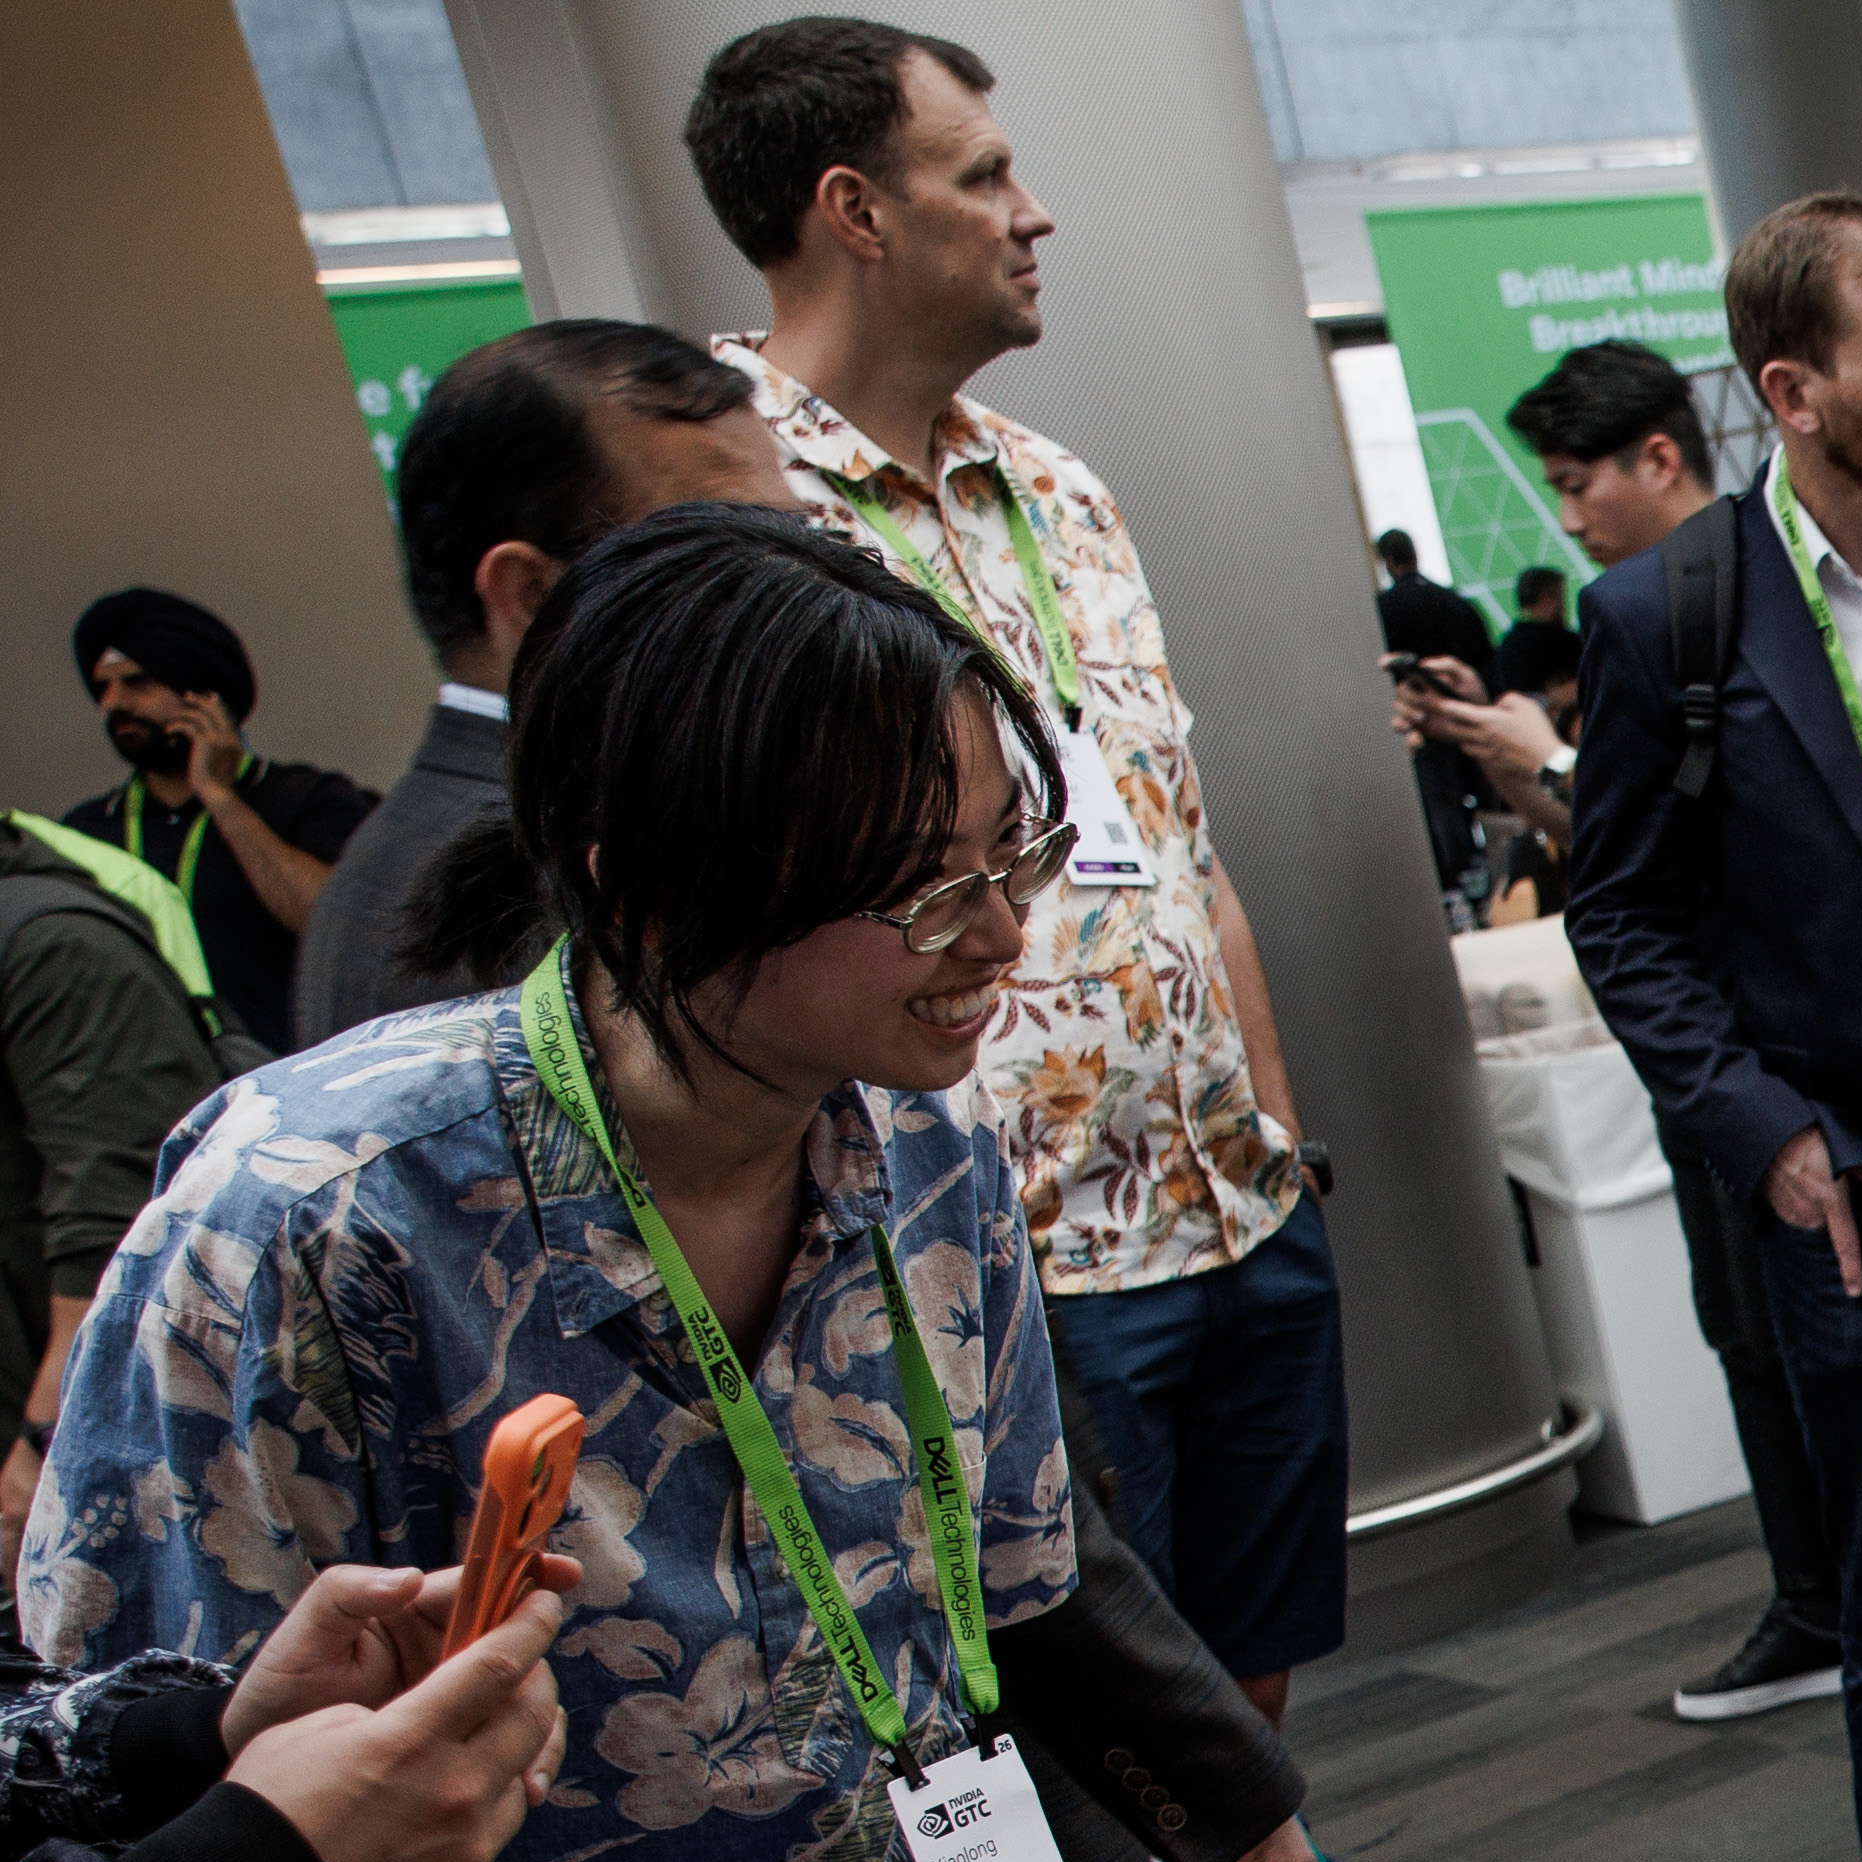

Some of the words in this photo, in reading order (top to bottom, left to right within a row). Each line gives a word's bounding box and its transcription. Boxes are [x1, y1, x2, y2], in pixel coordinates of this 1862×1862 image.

[1499, 265, 1637, 308] Brilliant
[1639, 256, 1726, 296] Mind
[694, 1305, 726, 1356] GTC
[923, 1436, 957, 1504] DELL
[778, 1504, 850, 1645] Technologies
[938, 1500, 977, 1642] Technologies
[839, 1633, 879, 1704] DELL
[948, 1787, 985, 1809] NVIDIA
[954, 1798, 992, 1828] GTC
